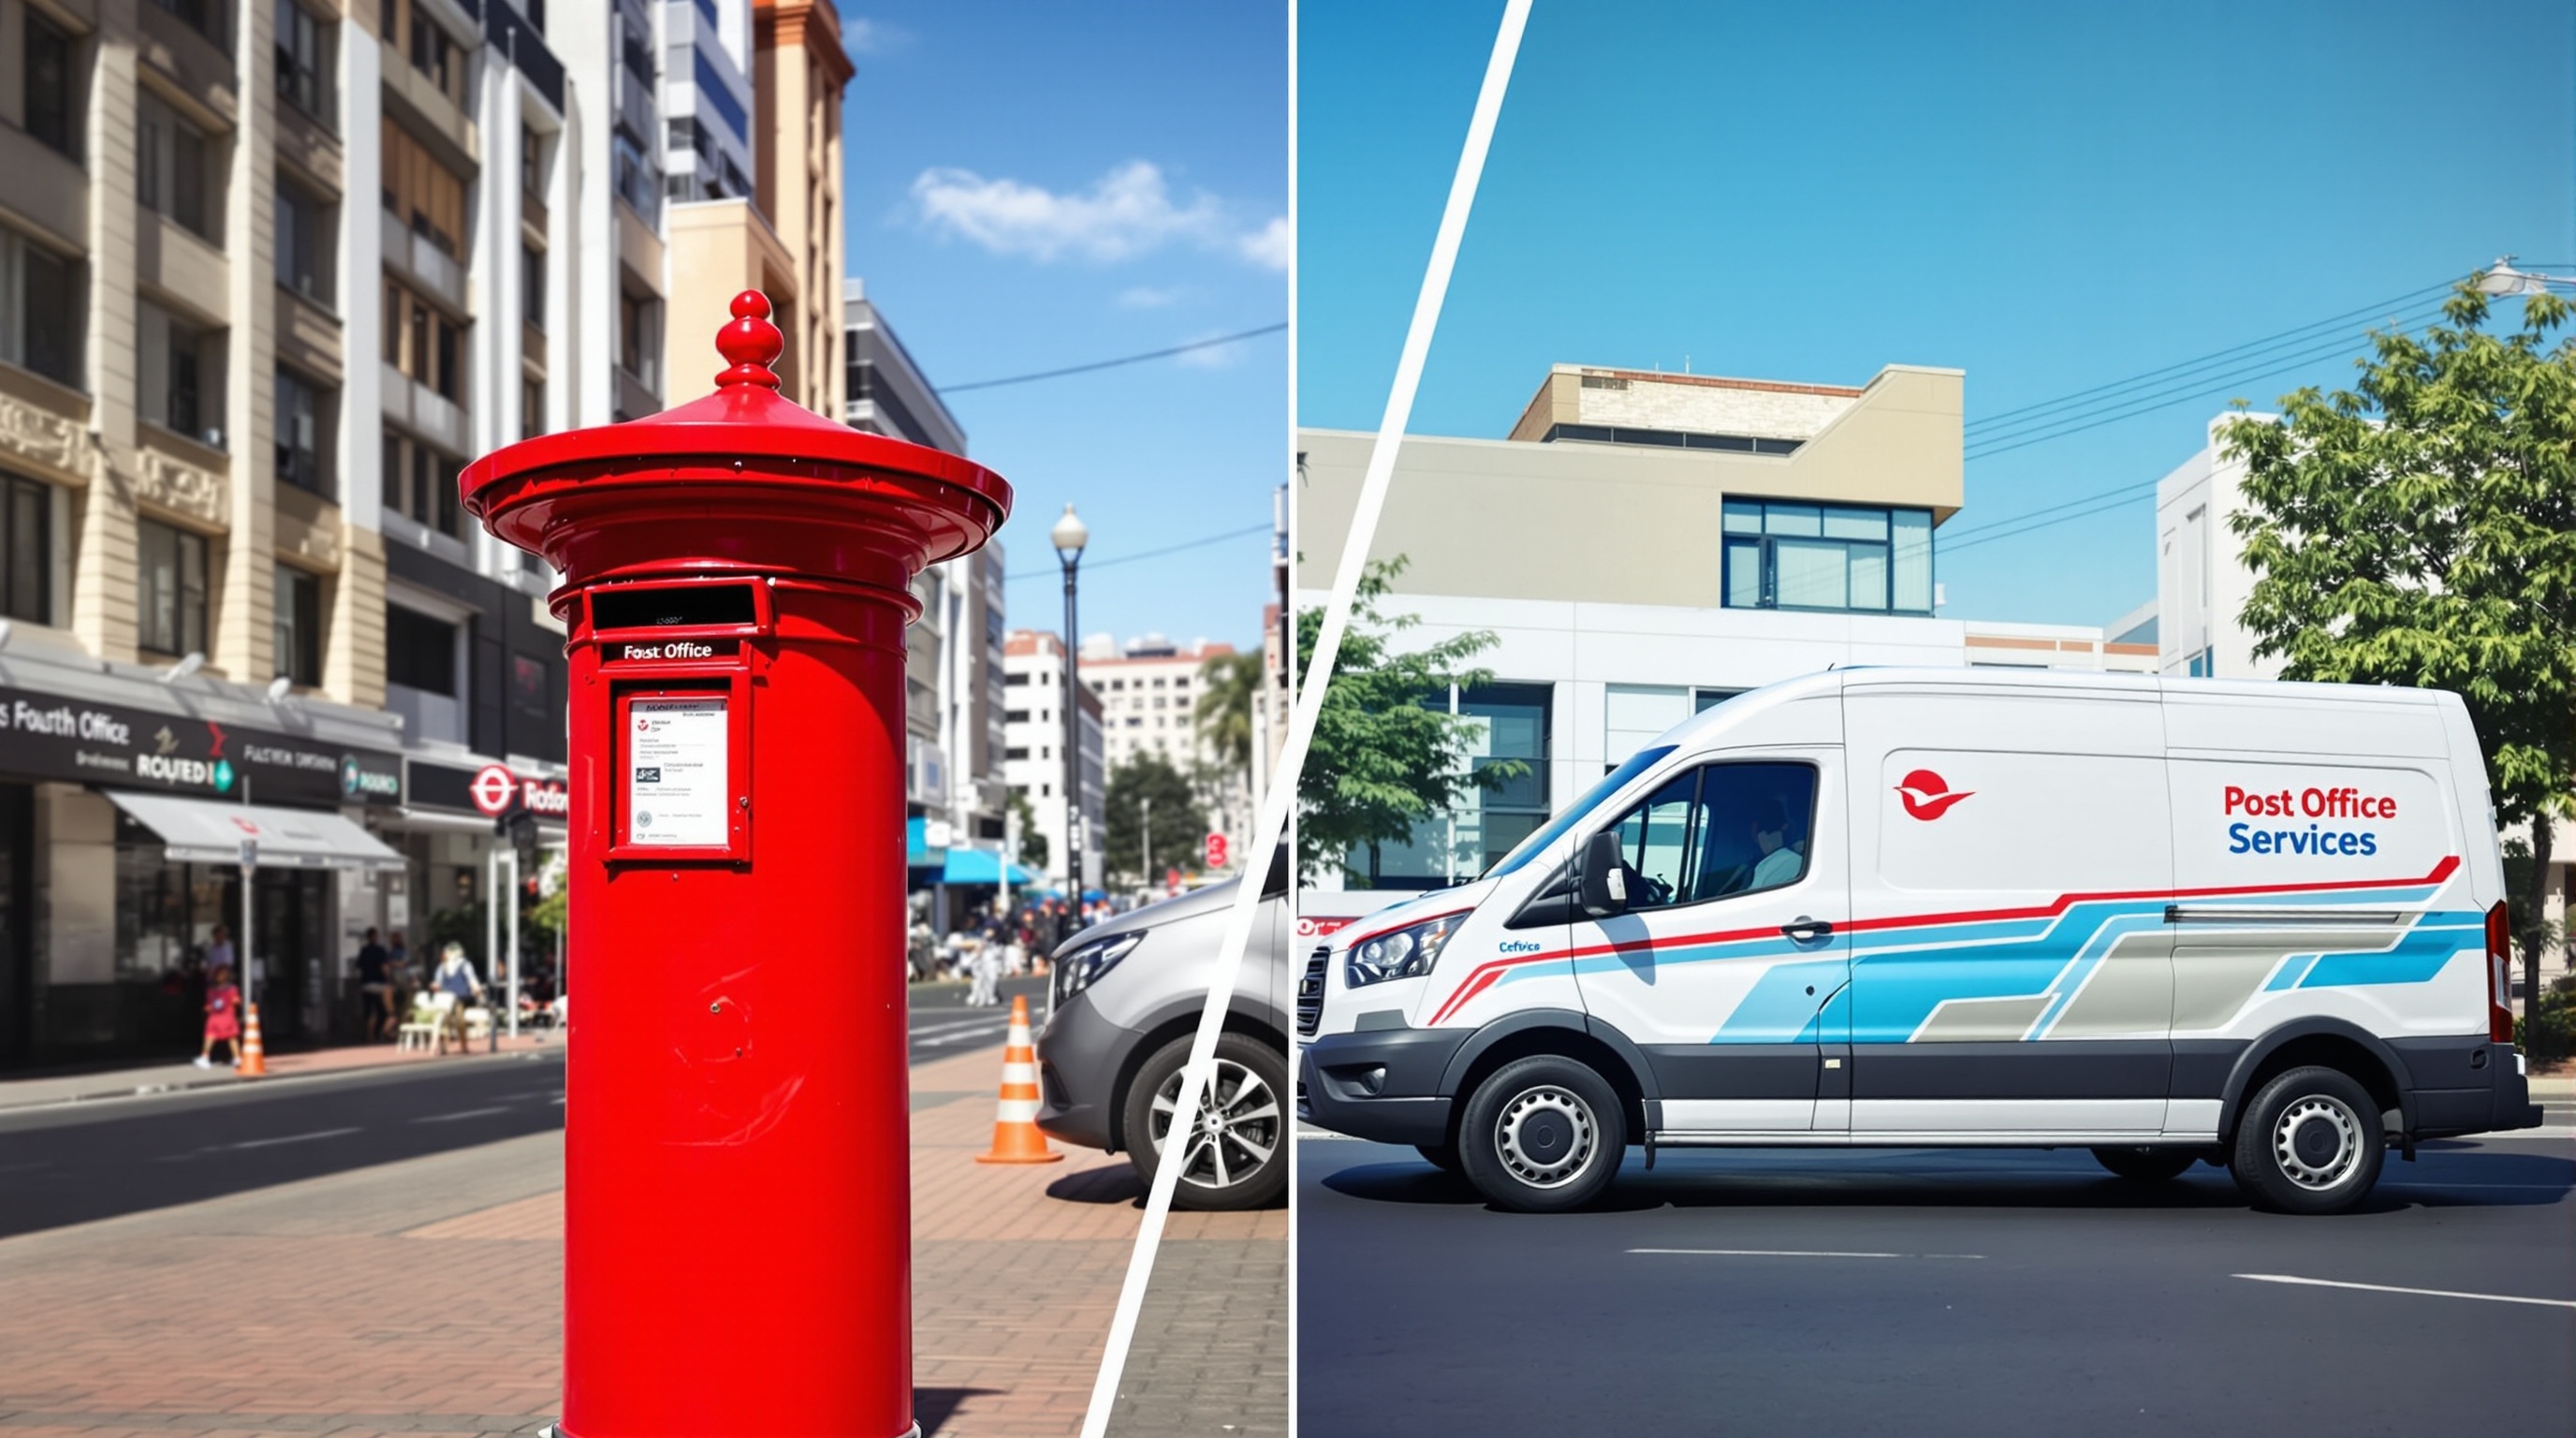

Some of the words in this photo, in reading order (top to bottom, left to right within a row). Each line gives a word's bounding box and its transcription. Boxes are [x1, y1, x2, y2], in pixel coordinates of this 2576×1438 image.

[664, 642, 712, 658] Office
[79, 712, 130, 745] Office
[2224, 785, 2295, 817] Post
[2301, 787, 2397, 819] Office
[2228, 822, 2378, 857] Services
